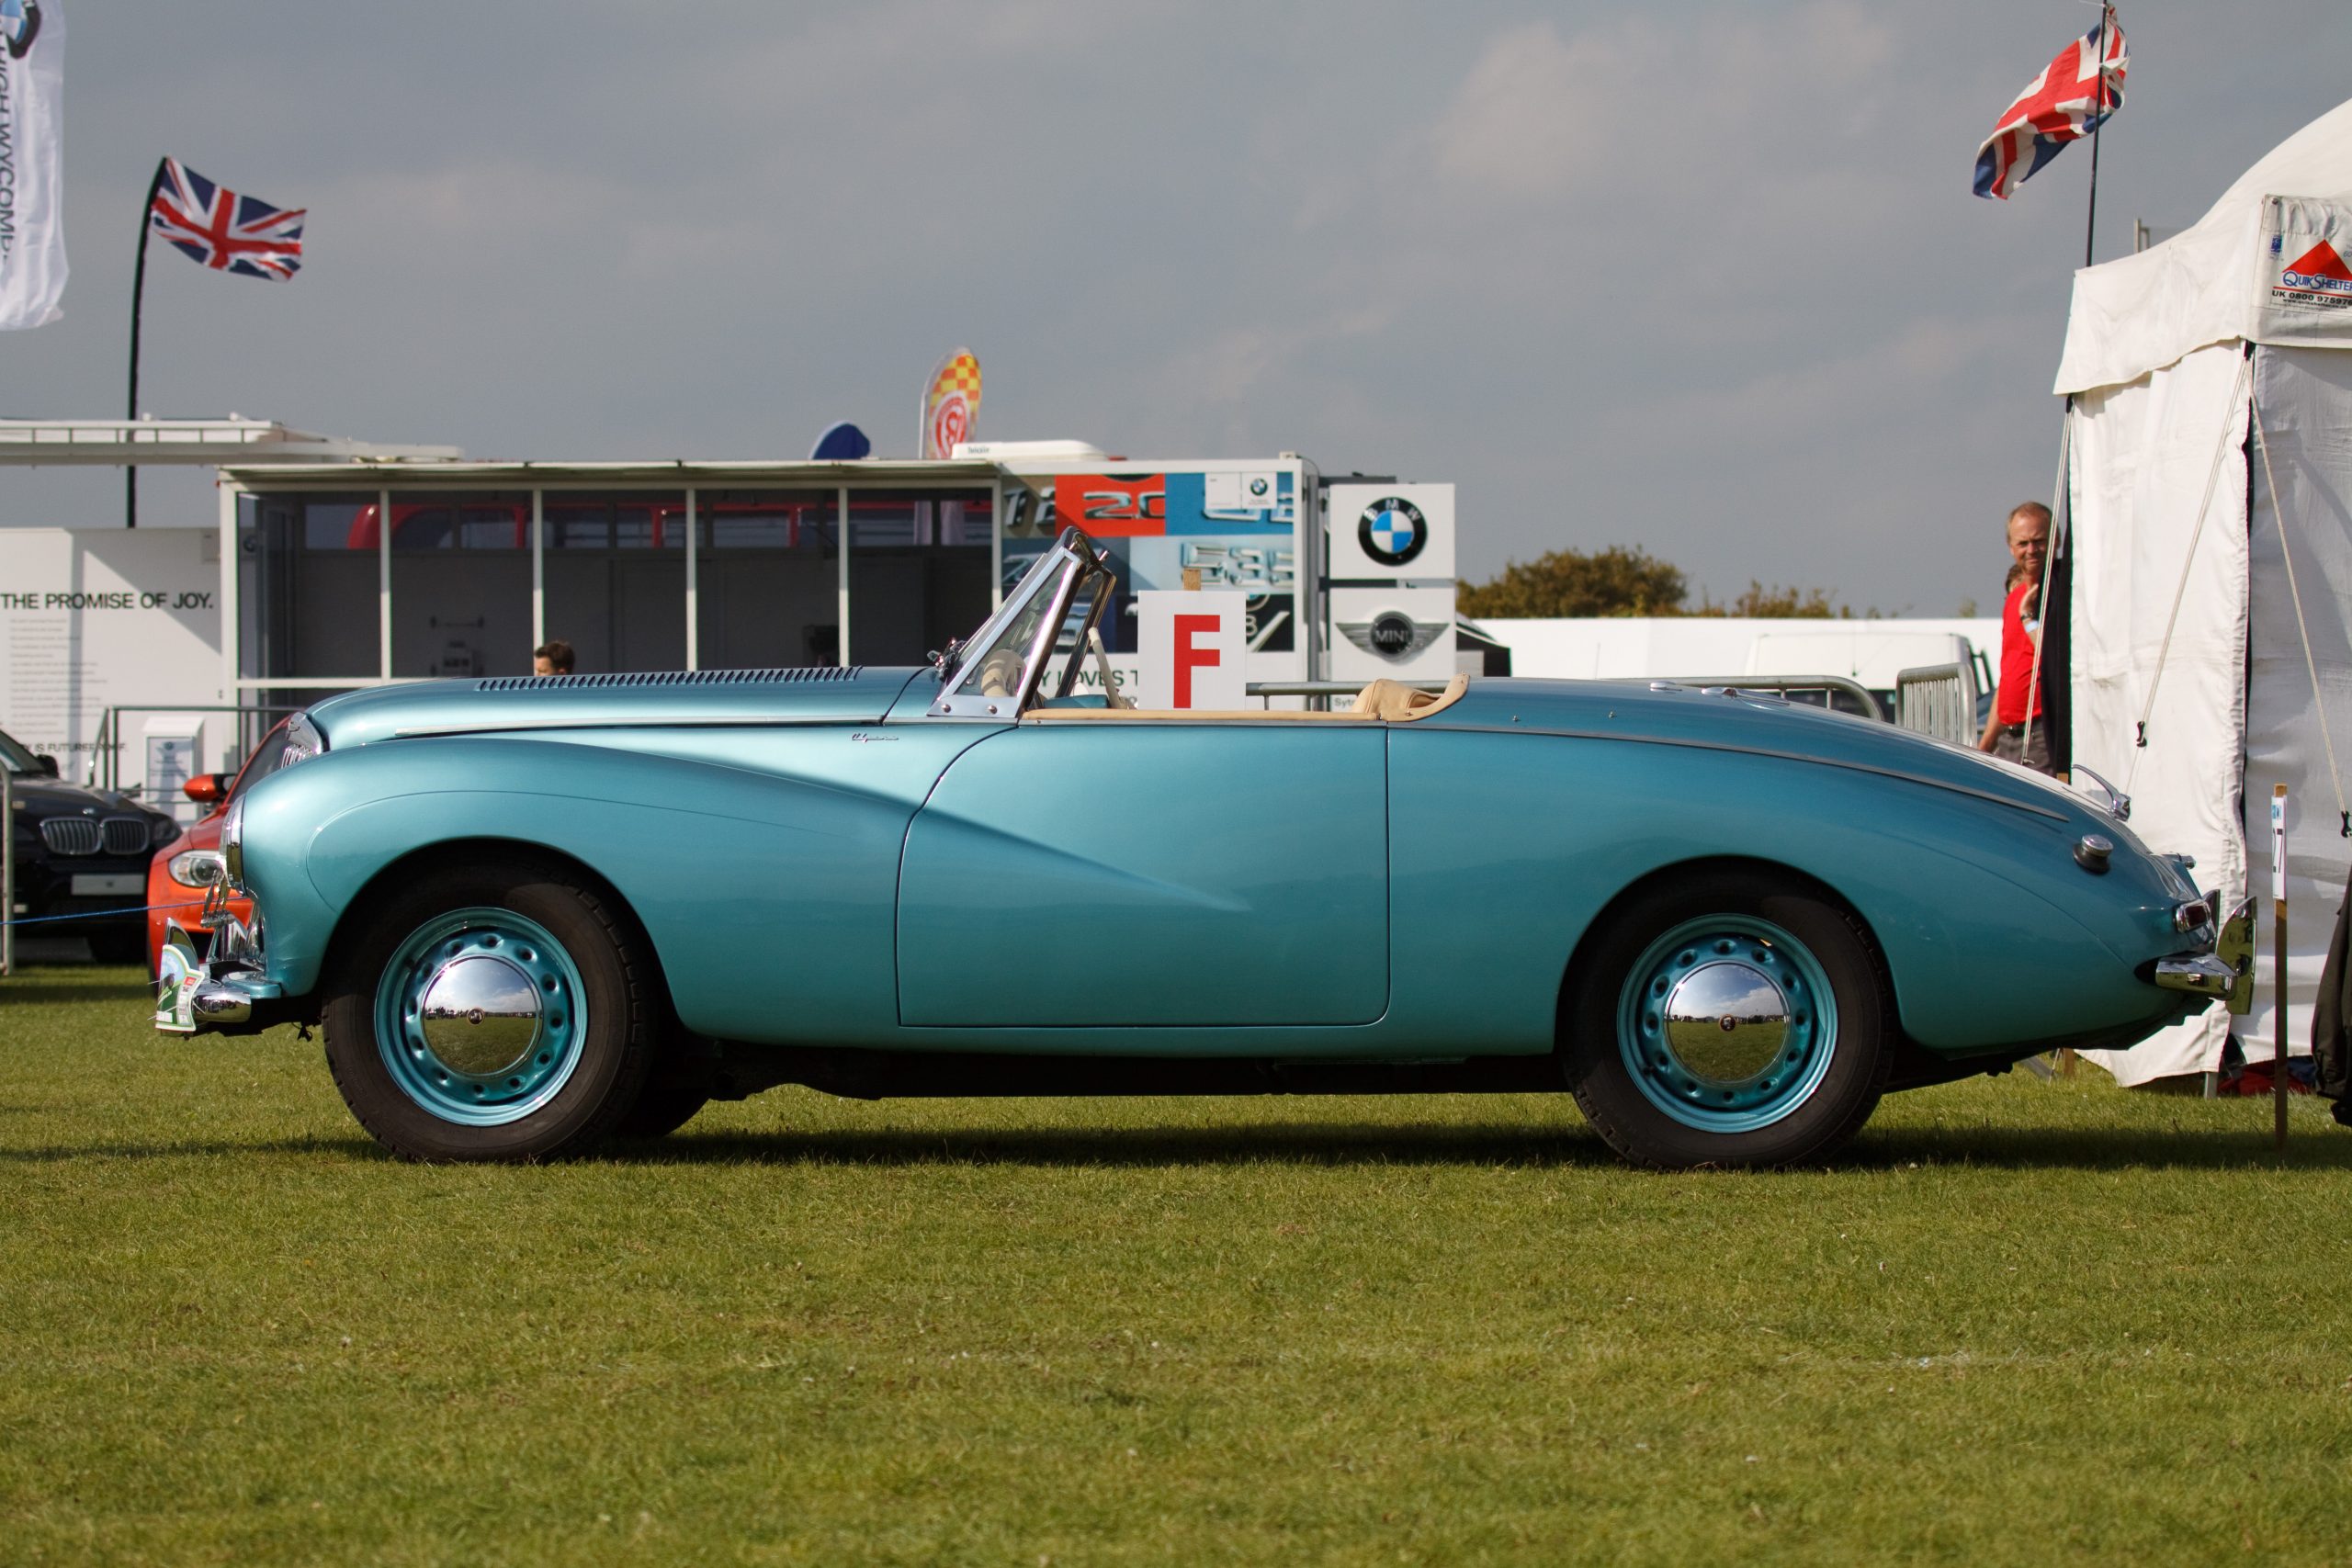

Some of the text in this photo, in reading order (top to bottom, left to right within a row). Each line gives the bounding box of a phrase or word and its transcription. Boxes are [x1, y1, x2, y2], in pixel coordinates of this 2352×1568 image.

[0, 122, 15, 264] WYCOM
[2272, 289, 2286, 298] UK
[2289, 292, 2314, 301] 0800
[1363, 499, 1421, 522] BMW
[2, 592, 213, 609] THE PROMISE OF JOY.
[1375, 629, 1409, 643] MINI
[1173, 615, 1220, 708] F
